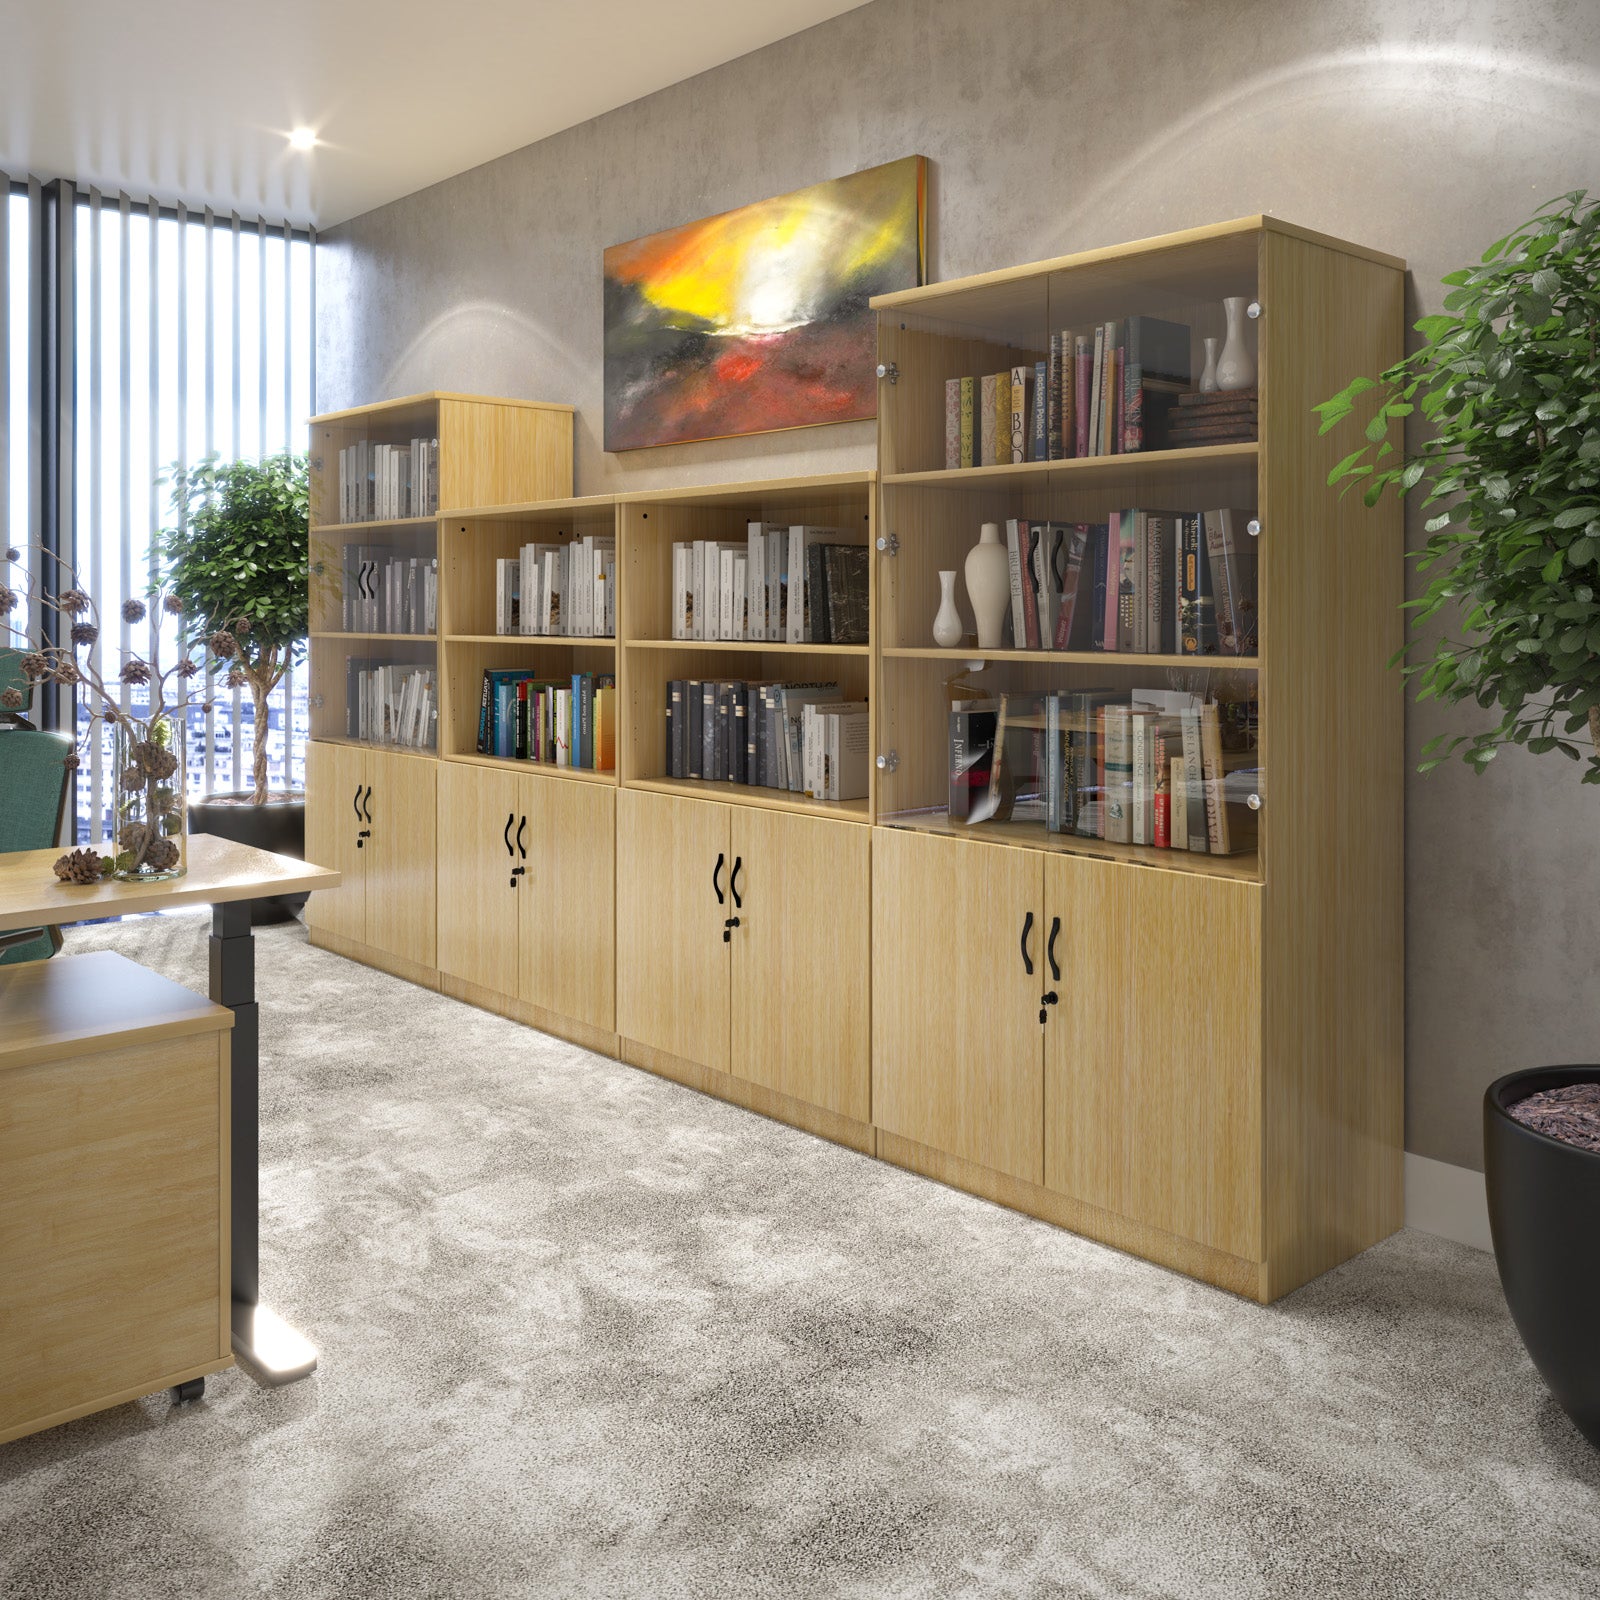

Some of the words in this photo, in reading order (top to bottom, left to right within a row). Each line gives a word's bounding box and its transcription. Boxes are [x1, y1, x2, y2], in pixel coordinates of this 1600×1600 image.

[1036, 373, 1045, 407] Jackson
[1036, 408, 1045, 440] Pollock
[1152, 520, 1162, 575] MARGARET
[1009, 551, 1021, 598] BRUEGEL
[1153, 581, 1162, 623] ATWOOD
[954, 739, 964, 776] INFERNO
[1203, 758, 1219, 845] BAROQUE
